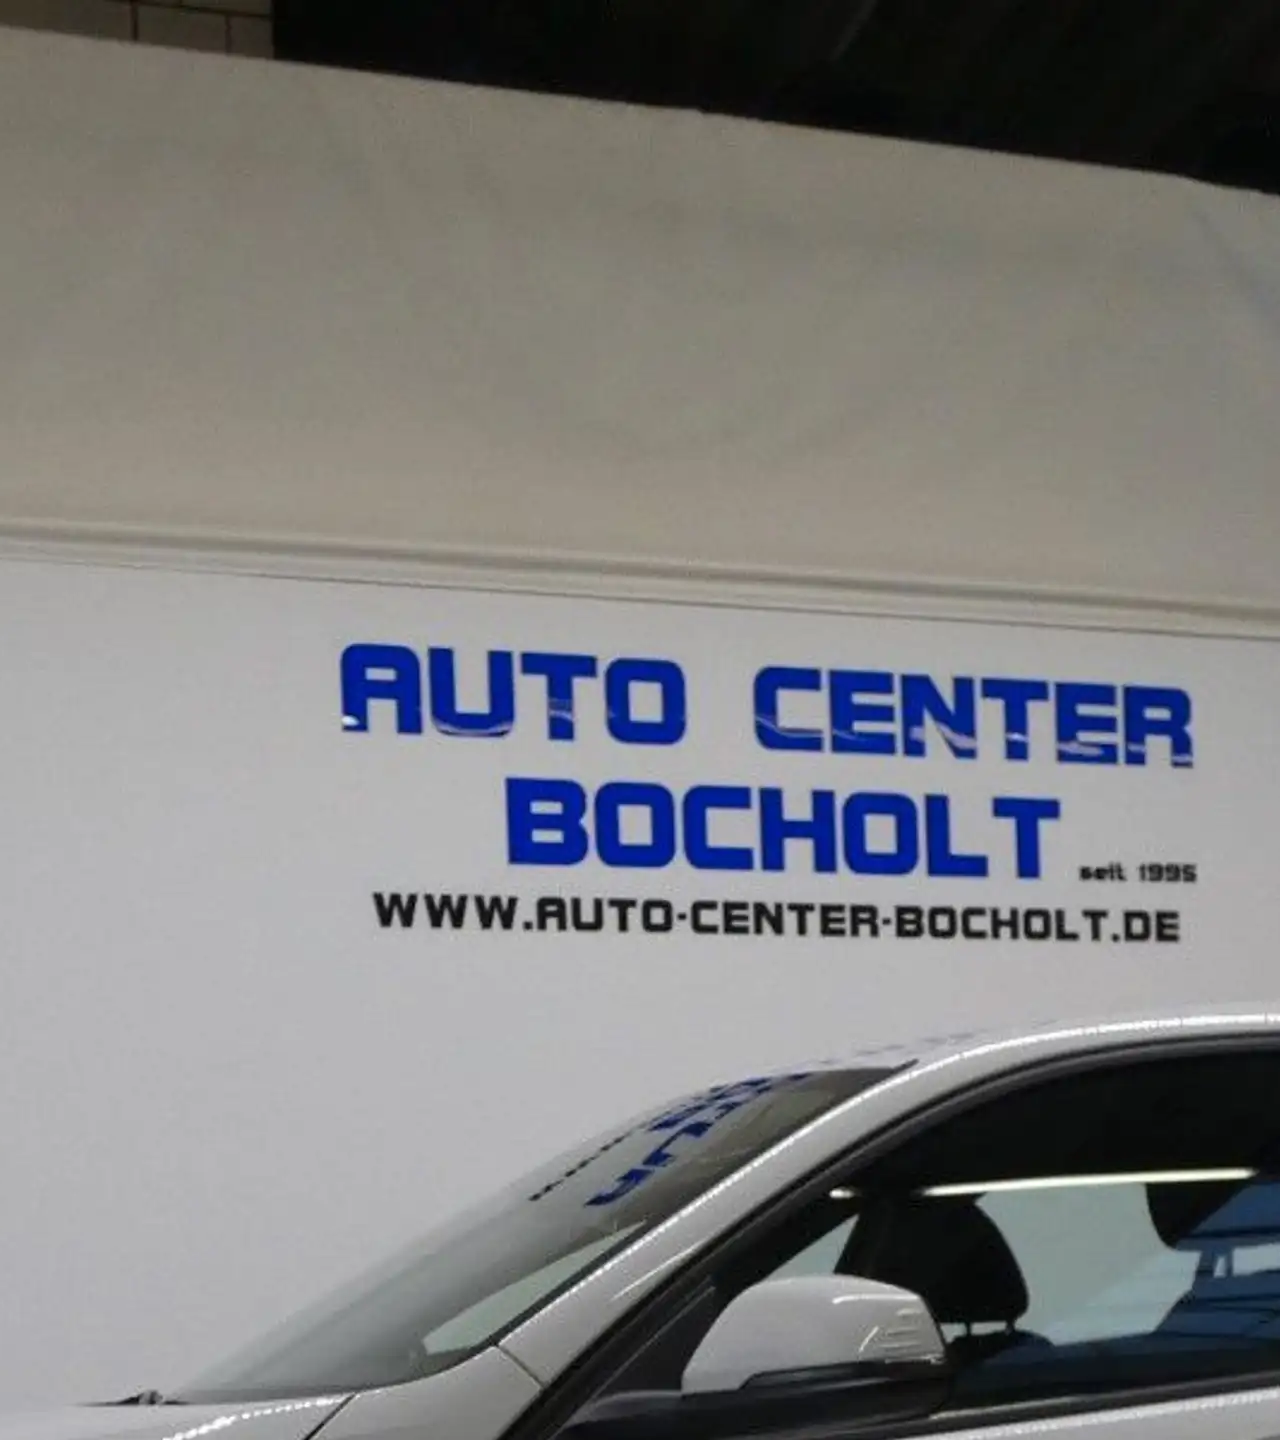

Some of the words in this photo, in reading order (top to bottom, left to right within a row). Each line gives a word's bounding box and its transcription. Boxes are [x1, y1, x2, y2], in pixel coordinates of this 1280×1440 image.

[339, 642, 688, 747] AUTO
[754, 665, 1193, 767] CENTER
[504, 775, 1062, 882] BOCHOLT
[1079, 862, 1126, 882] seit
[1138, 862, 1198, 883] 1995
[372, 891, 1180, 943] WWW.AUTO-CENTER-BOCHOLT.DE
